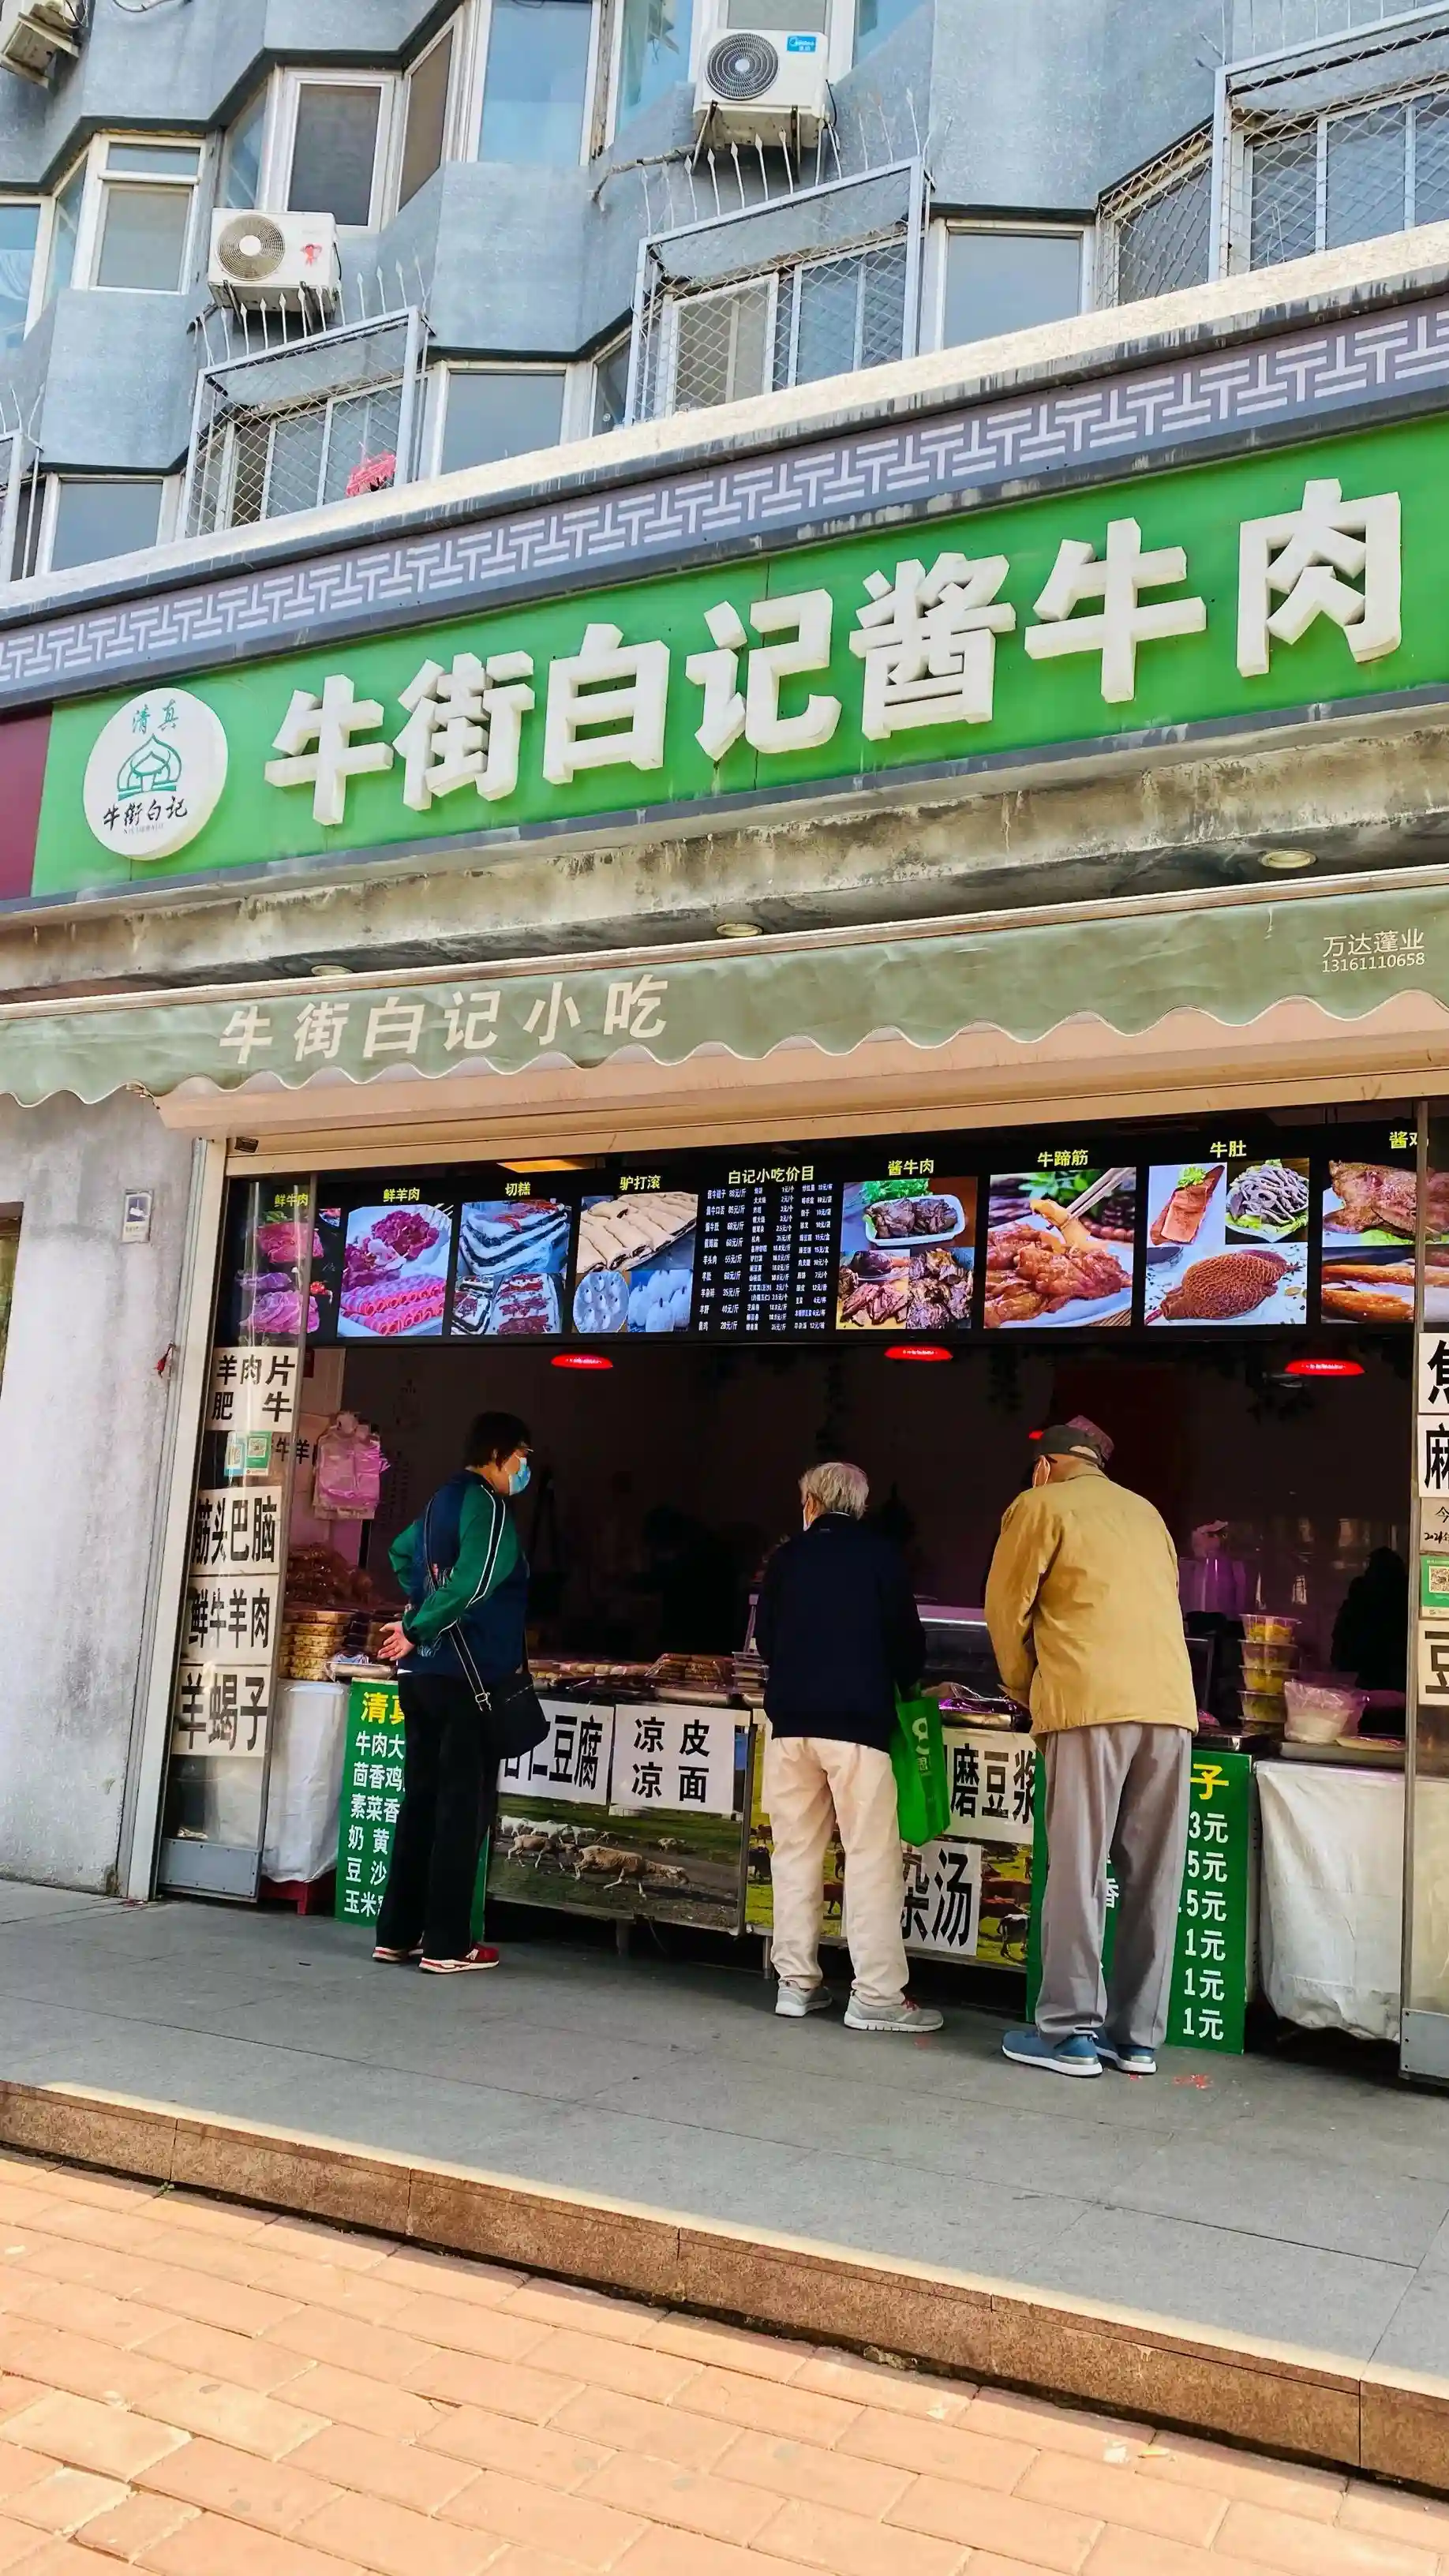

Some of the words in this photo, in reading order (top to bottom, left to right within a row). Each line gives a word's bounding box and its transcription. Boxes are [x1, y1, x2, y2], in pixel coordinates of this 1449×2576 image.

[265, 478, 1402, 826] 牛街白记酱牛肉
[132, 699, 178, 735] 清真
[103, 796, 188, 831] 牛街白记
[1322, 952, 1425, 973] 13161110658
[219, 974, 668, 1065] 牛街白记小吃
[1038, 1150, 1089, 1168] 牛蹄筋
[1210, 1139, 1246, 1158] 牛肚
[620, 1175, 661, 1191] 驴打滚
[728, 1166, 814, 1184] 白记小吃价目
[887, 1159, 934, 1178] 酱牛肉
[274, 1193, 309, 1208] 鲜牛肉
[384, 1188, 420, 1203] 鲜羊肉
[505, 1181, 530, 1197] 切糕
[217, 1354, 295, 1386] 羊肉片
[189, 1588, 270, 1649] 鲜牛羊肉
[178, 1672, 268, 1750] 羊蝎子
[355, 1730, 406, 1760] 牛肉大
[633, 1716, 710, 1758] 凉皮
[353, 1761, 406, 1792] 茴香鸡
[631, 1762, 710, 1803] 凉面
[943, 1743, 1036, 1825] 磨豆浆
[350, 1793, 401, 1823] 素菜香
[348, 1824, 390, 1855] 奶黄
[1189, 1812, 1229, 1844] 3元
[346, 1856, 387, 1886] 豆沙
[1185, 1929, 1226, 1962] 1元
[1184, 1968, 1225, 2001] 1元
[1182, 2007, 1224, 2040] 1元
